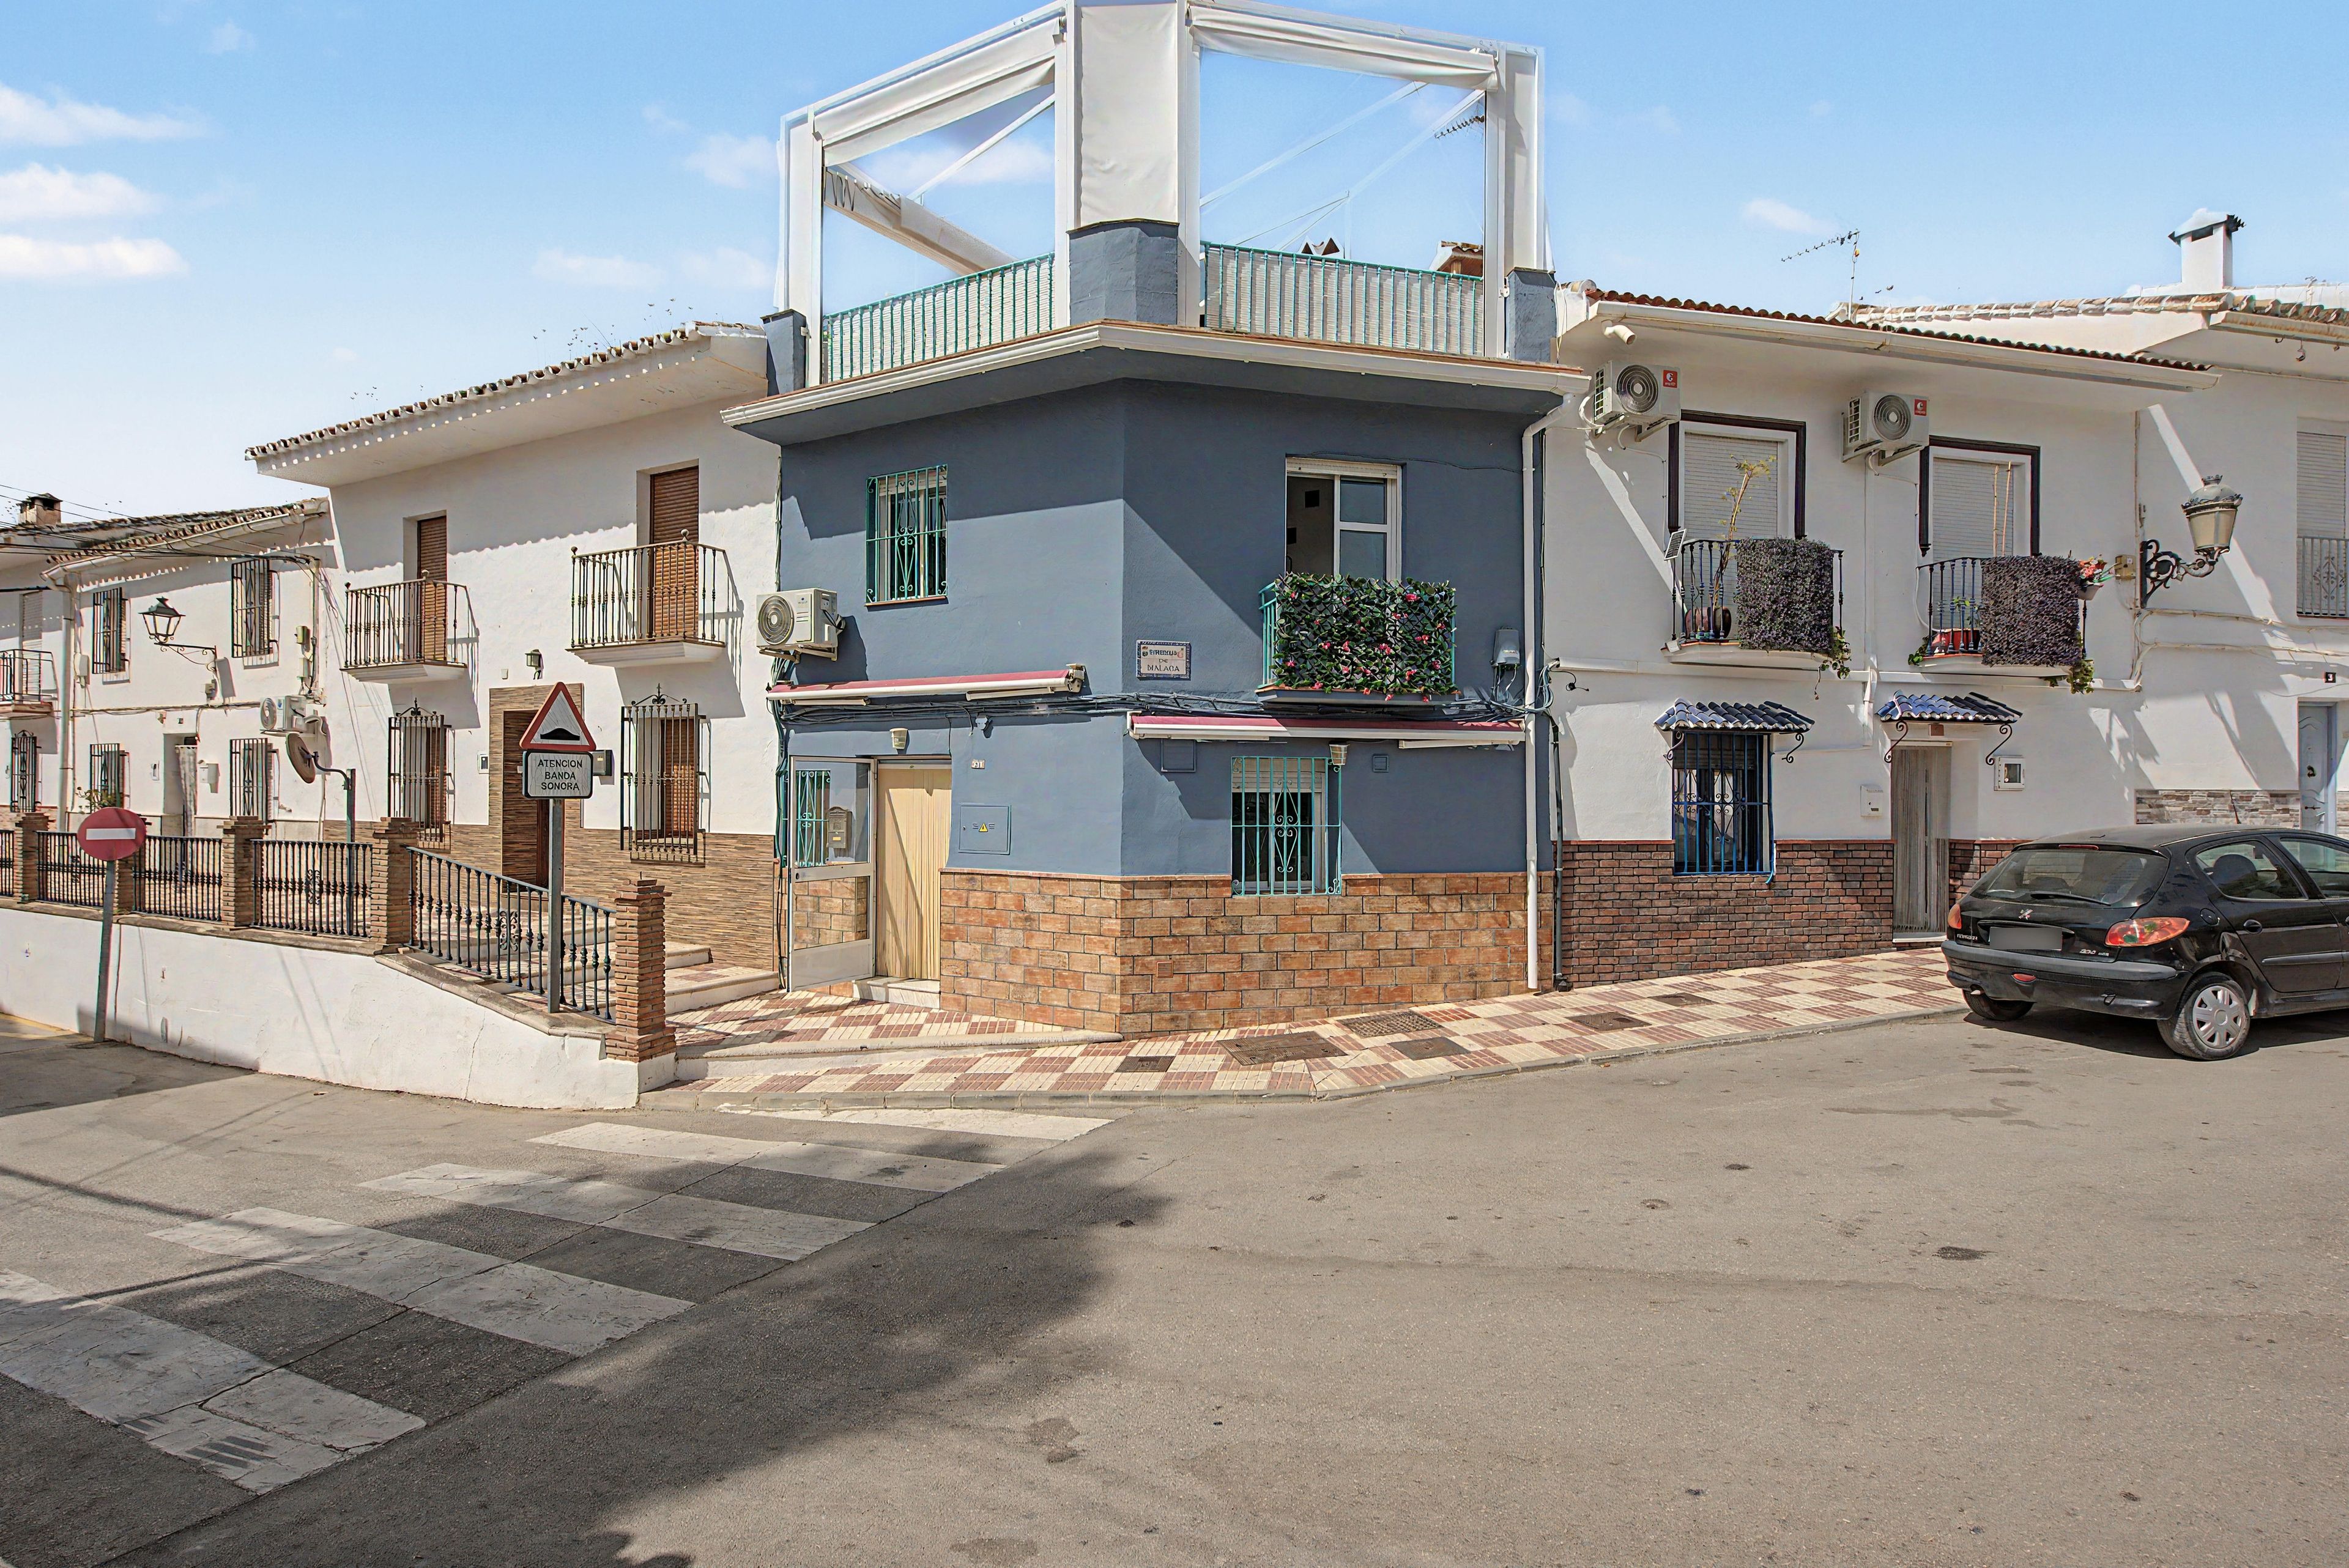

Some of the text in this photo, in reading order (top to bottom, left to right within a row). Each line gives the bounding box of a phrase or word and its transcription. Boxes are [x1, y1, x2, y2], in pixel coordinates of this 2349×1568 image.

[537, 759, 583, 768] ATENCION
[544, 771, 576, 780] BANDA
[541, 782, 580, 791] SONORA
